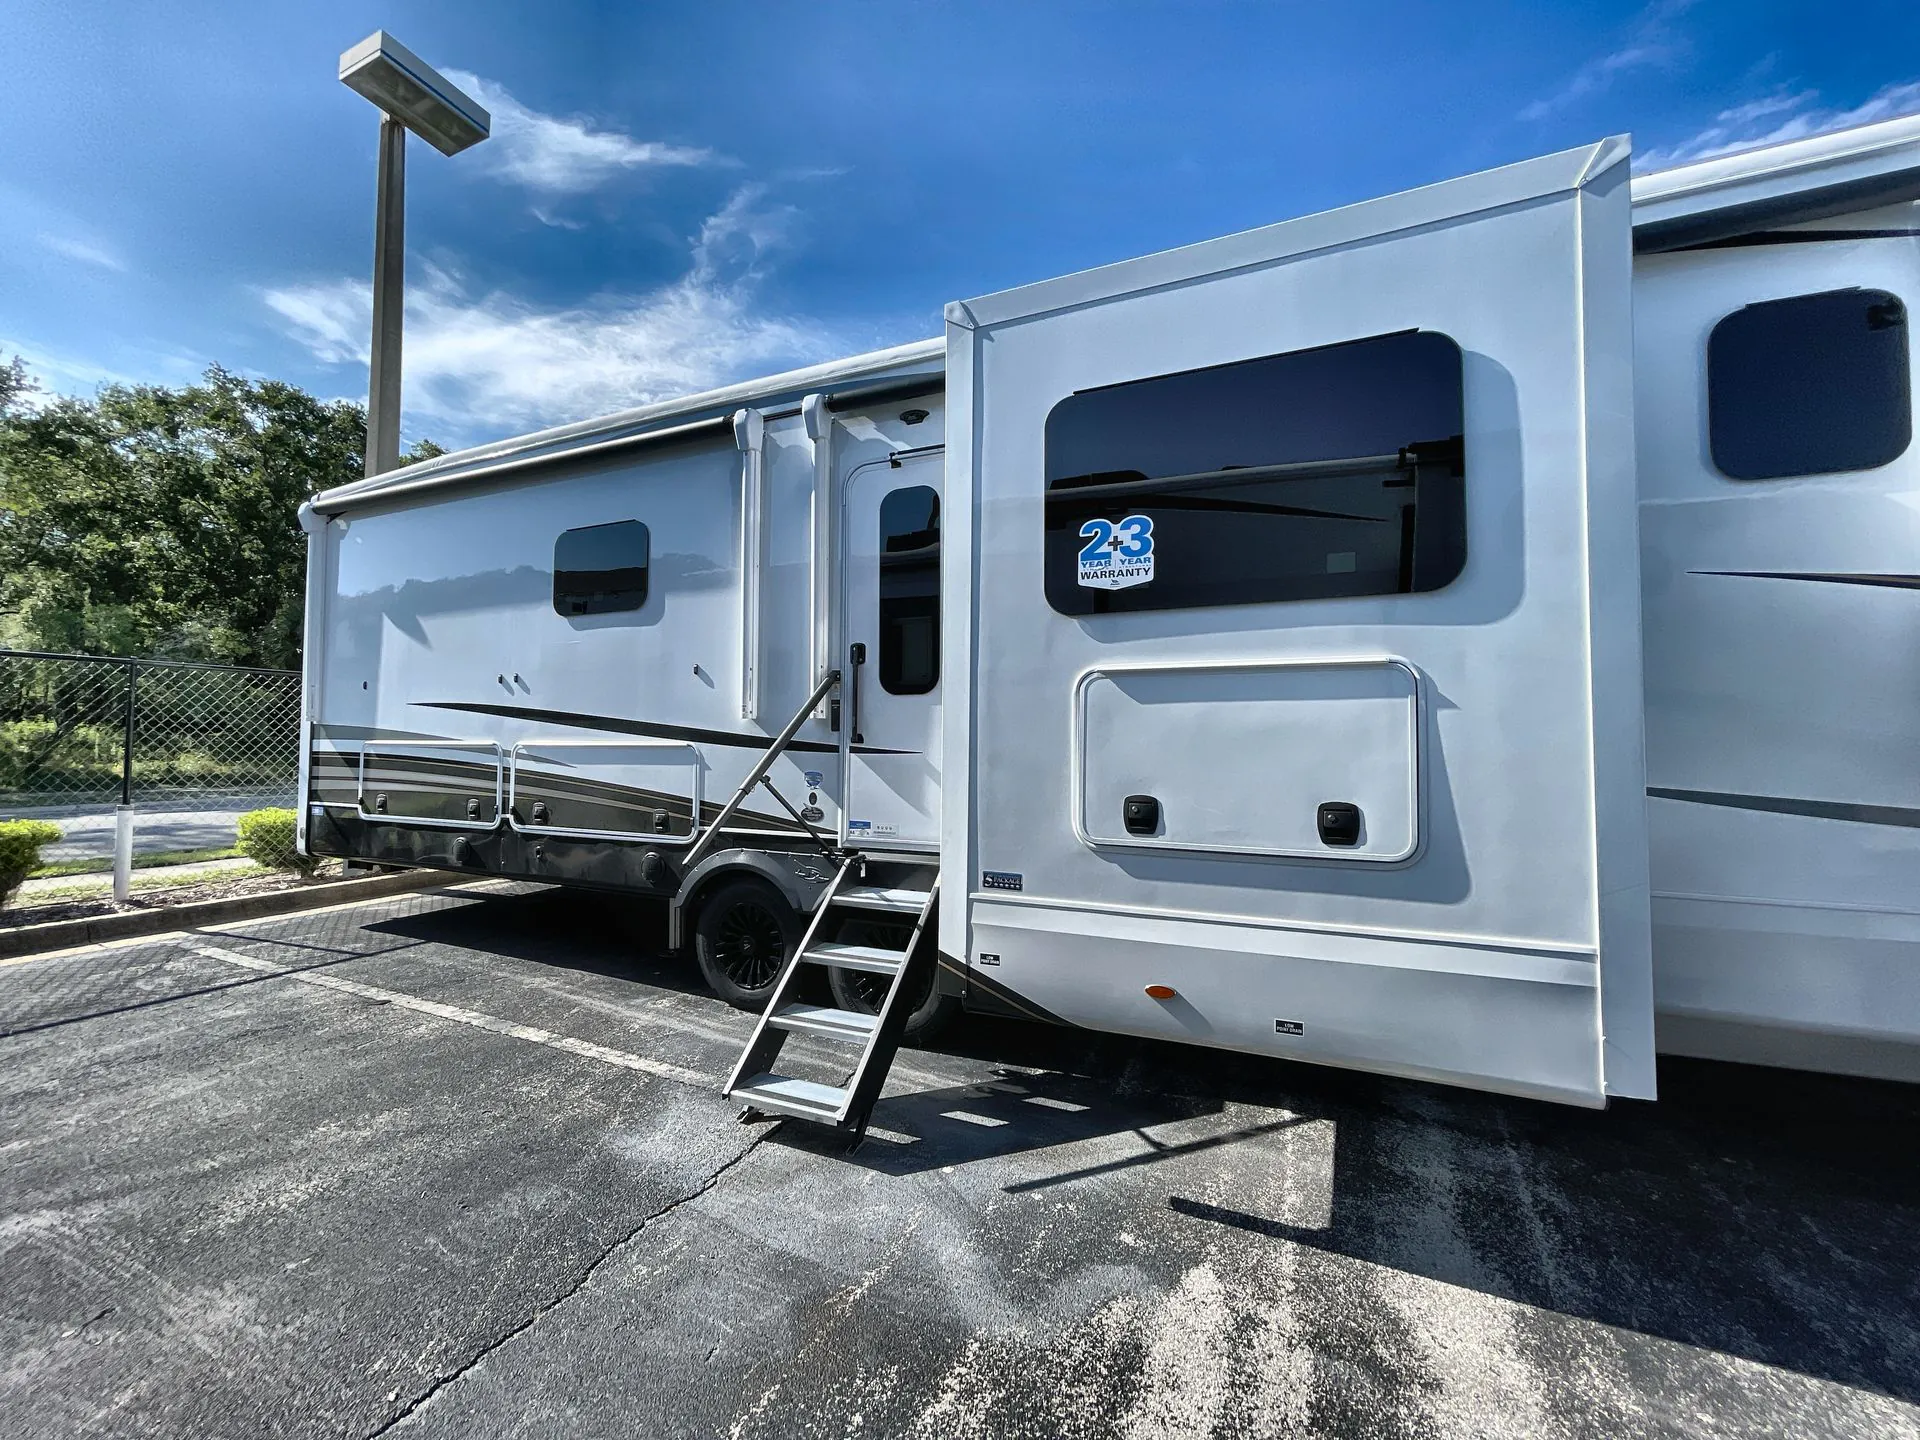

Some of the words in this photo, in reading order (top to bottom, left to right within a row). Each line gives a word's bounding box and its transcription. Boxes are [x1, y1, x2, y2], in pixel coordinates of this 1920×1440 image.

[1081, 560, 1111, 568] YEAR
[1119, 556, 1151, 566] YEAR
[1080, 567, 1151, 580] WARRANTY
[993, 876, 1020, 885] PACKAGE
